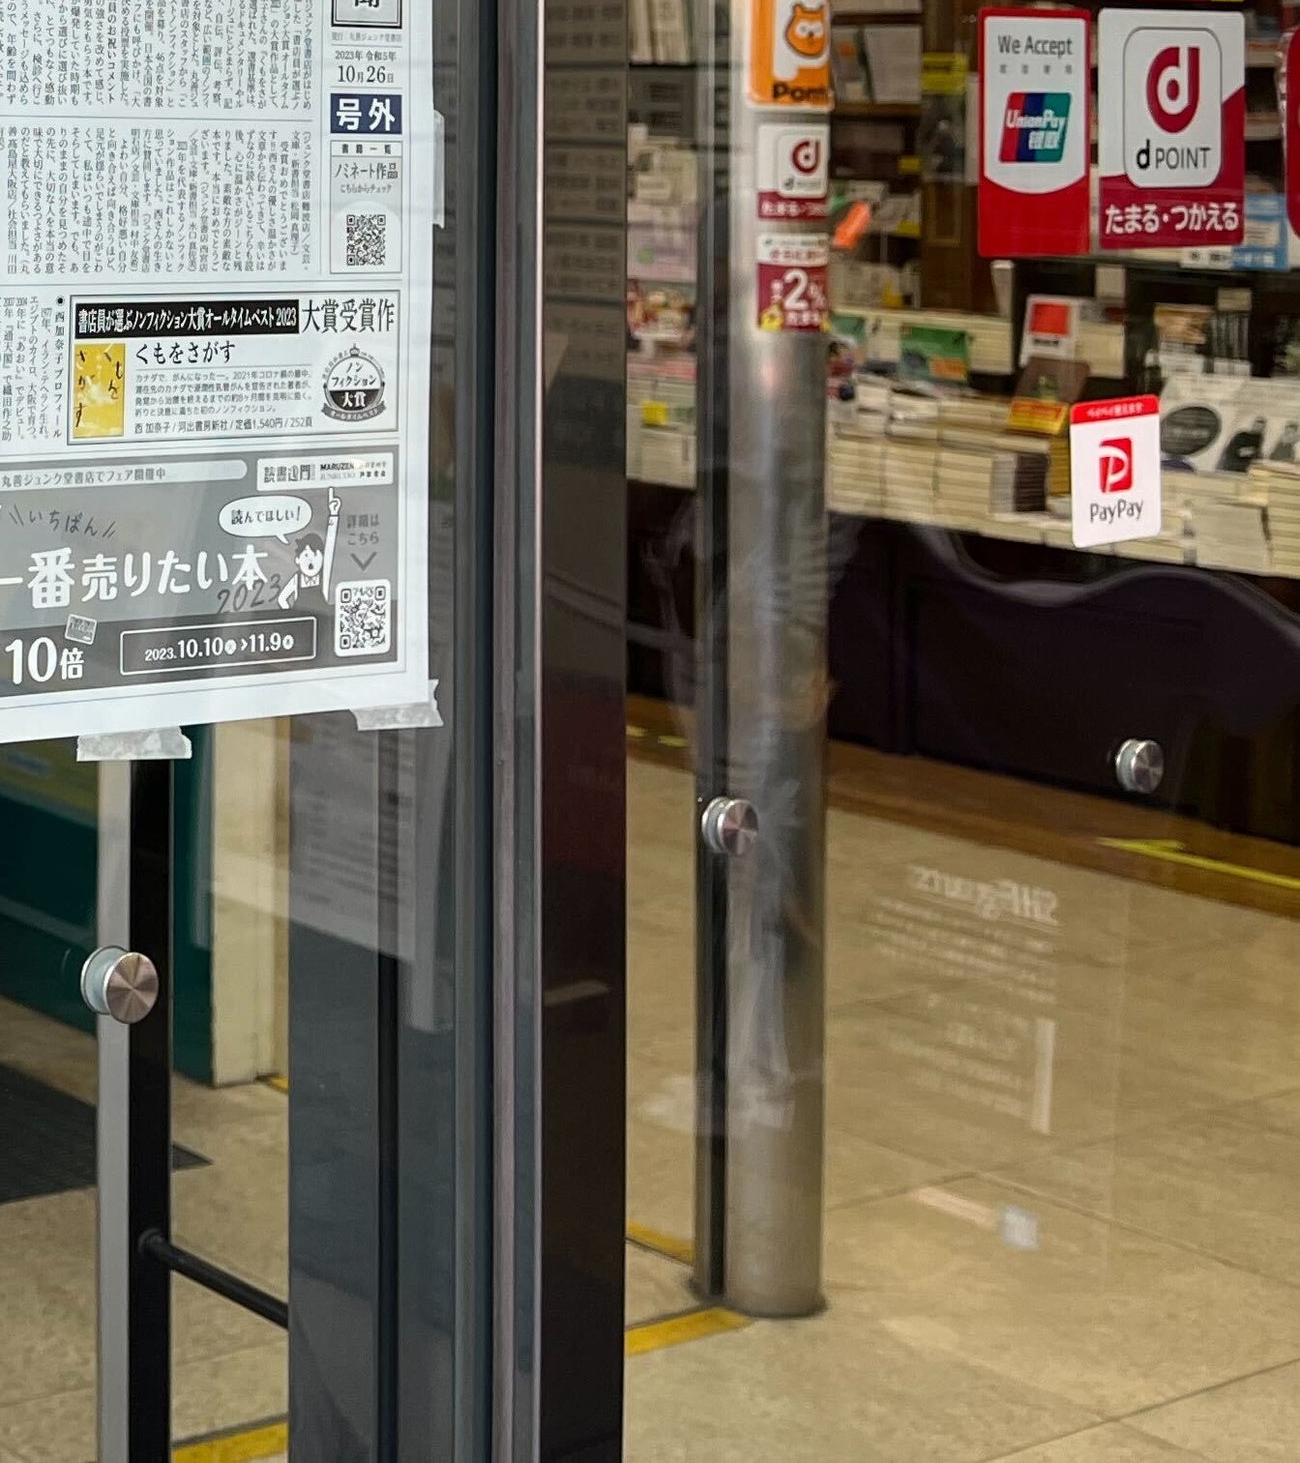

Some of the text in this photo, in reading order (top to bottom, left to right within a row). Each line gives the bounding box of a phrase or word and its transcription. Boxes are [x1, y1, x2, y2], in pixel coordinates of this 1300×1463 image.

[997, 35, 1074, 60] We Accept
[337, 64, 395, 84] 10月26日
[335, 97, 397, 132] 号外
[1006, 108, 1069, 137] UnionPay
[334, 162, 399, 180] ノミネート作品
[1155, 147, 1211, 170] POINT
[1104, 201, 1241, 235] たまる・つかえる
[276, 306, 298, 327] 2023
[301, 297, 396, 335] 大賞受賞作
[135, 341, 236, 365] くもをさがす
[28, 509, 98, 537] いちばん
[1089, 498, 1144, 524] PayPay
[347, 532, 380, 546] こちら
[216, 573, 283, 615] 2023
[4, 636, 86, 686] 10倍
